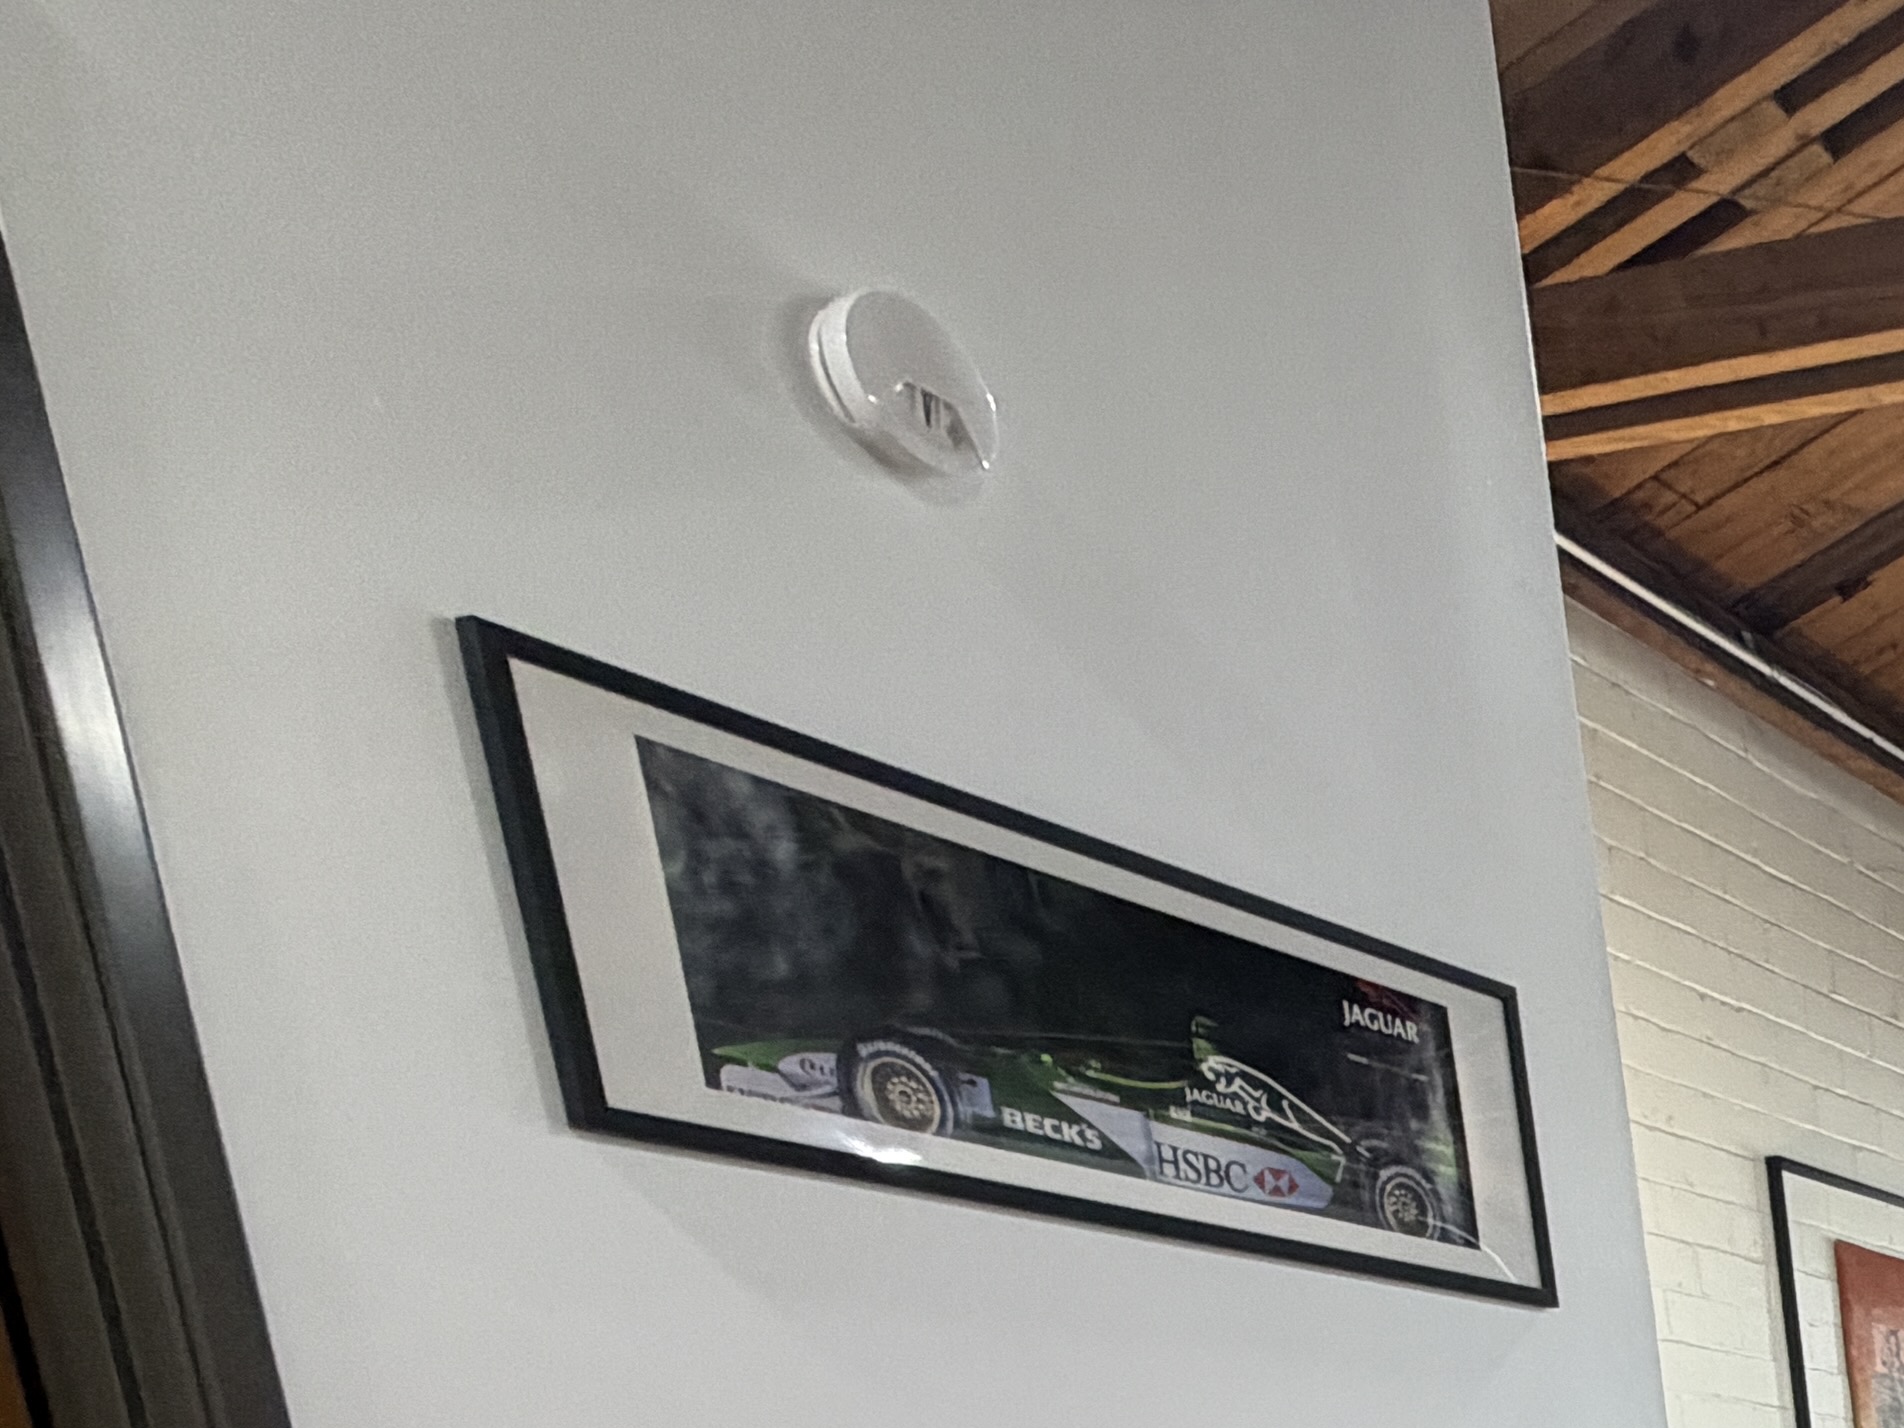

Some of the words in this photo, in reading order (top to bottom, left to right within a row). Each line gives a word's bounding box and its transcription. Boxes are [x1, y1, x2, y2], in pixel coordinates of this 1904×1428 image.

[1342, 999, 1420, 1044] JAGUAR
[1184, 1086, 1247, 1116] JAGUAR
[1000, 1106, 1103, 1150] BECK'S
[1154, 1141, 1250, 1194] HSBC
